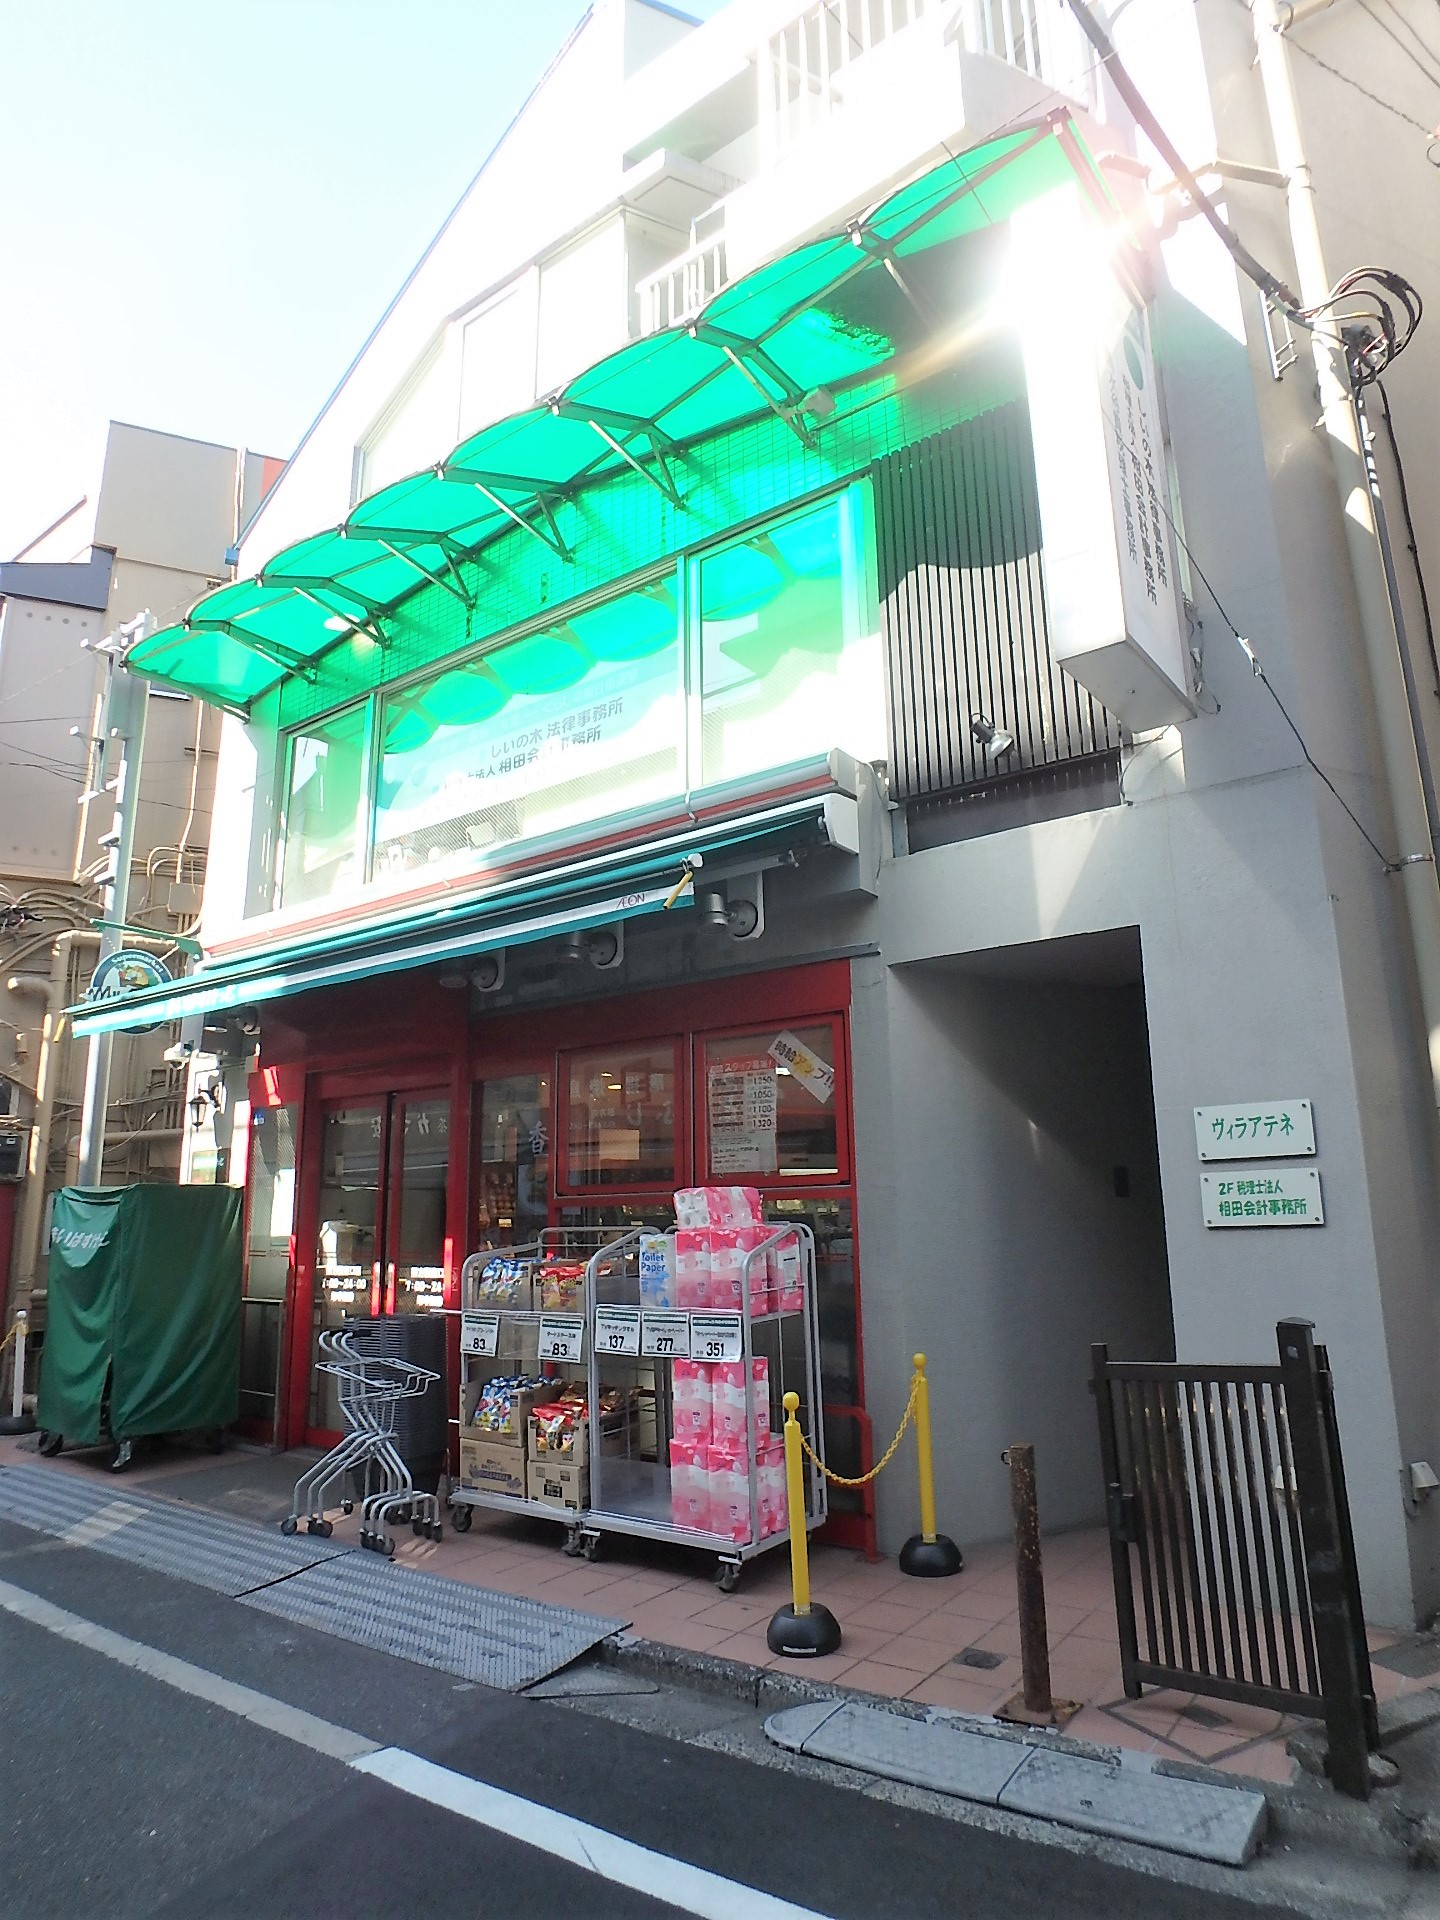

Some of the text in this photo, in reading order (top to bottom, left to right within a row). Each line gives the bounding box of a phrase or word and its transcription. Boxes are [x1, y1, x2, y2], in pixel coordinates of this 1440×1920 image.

[111, 954, 164, 974] Supermarket
[1211, 1113, 1294, 1140] ヴィラアテネ
[1218, 1183, 1234, 1195] 2F
[1218, 1198, 1307, 1216] 相田会計事務所
[641, 1251, 665, 1262] Toilet
[641, 1262, 666, 1272] Paper
[472, 1337, 486, 1350] 83
[551, 1342, 568, 1357] 83
[608, 1335, 625, 1349] 137
[656, 1337, 674, 1352] 277
[706, 1342, 725, 1357] 351
